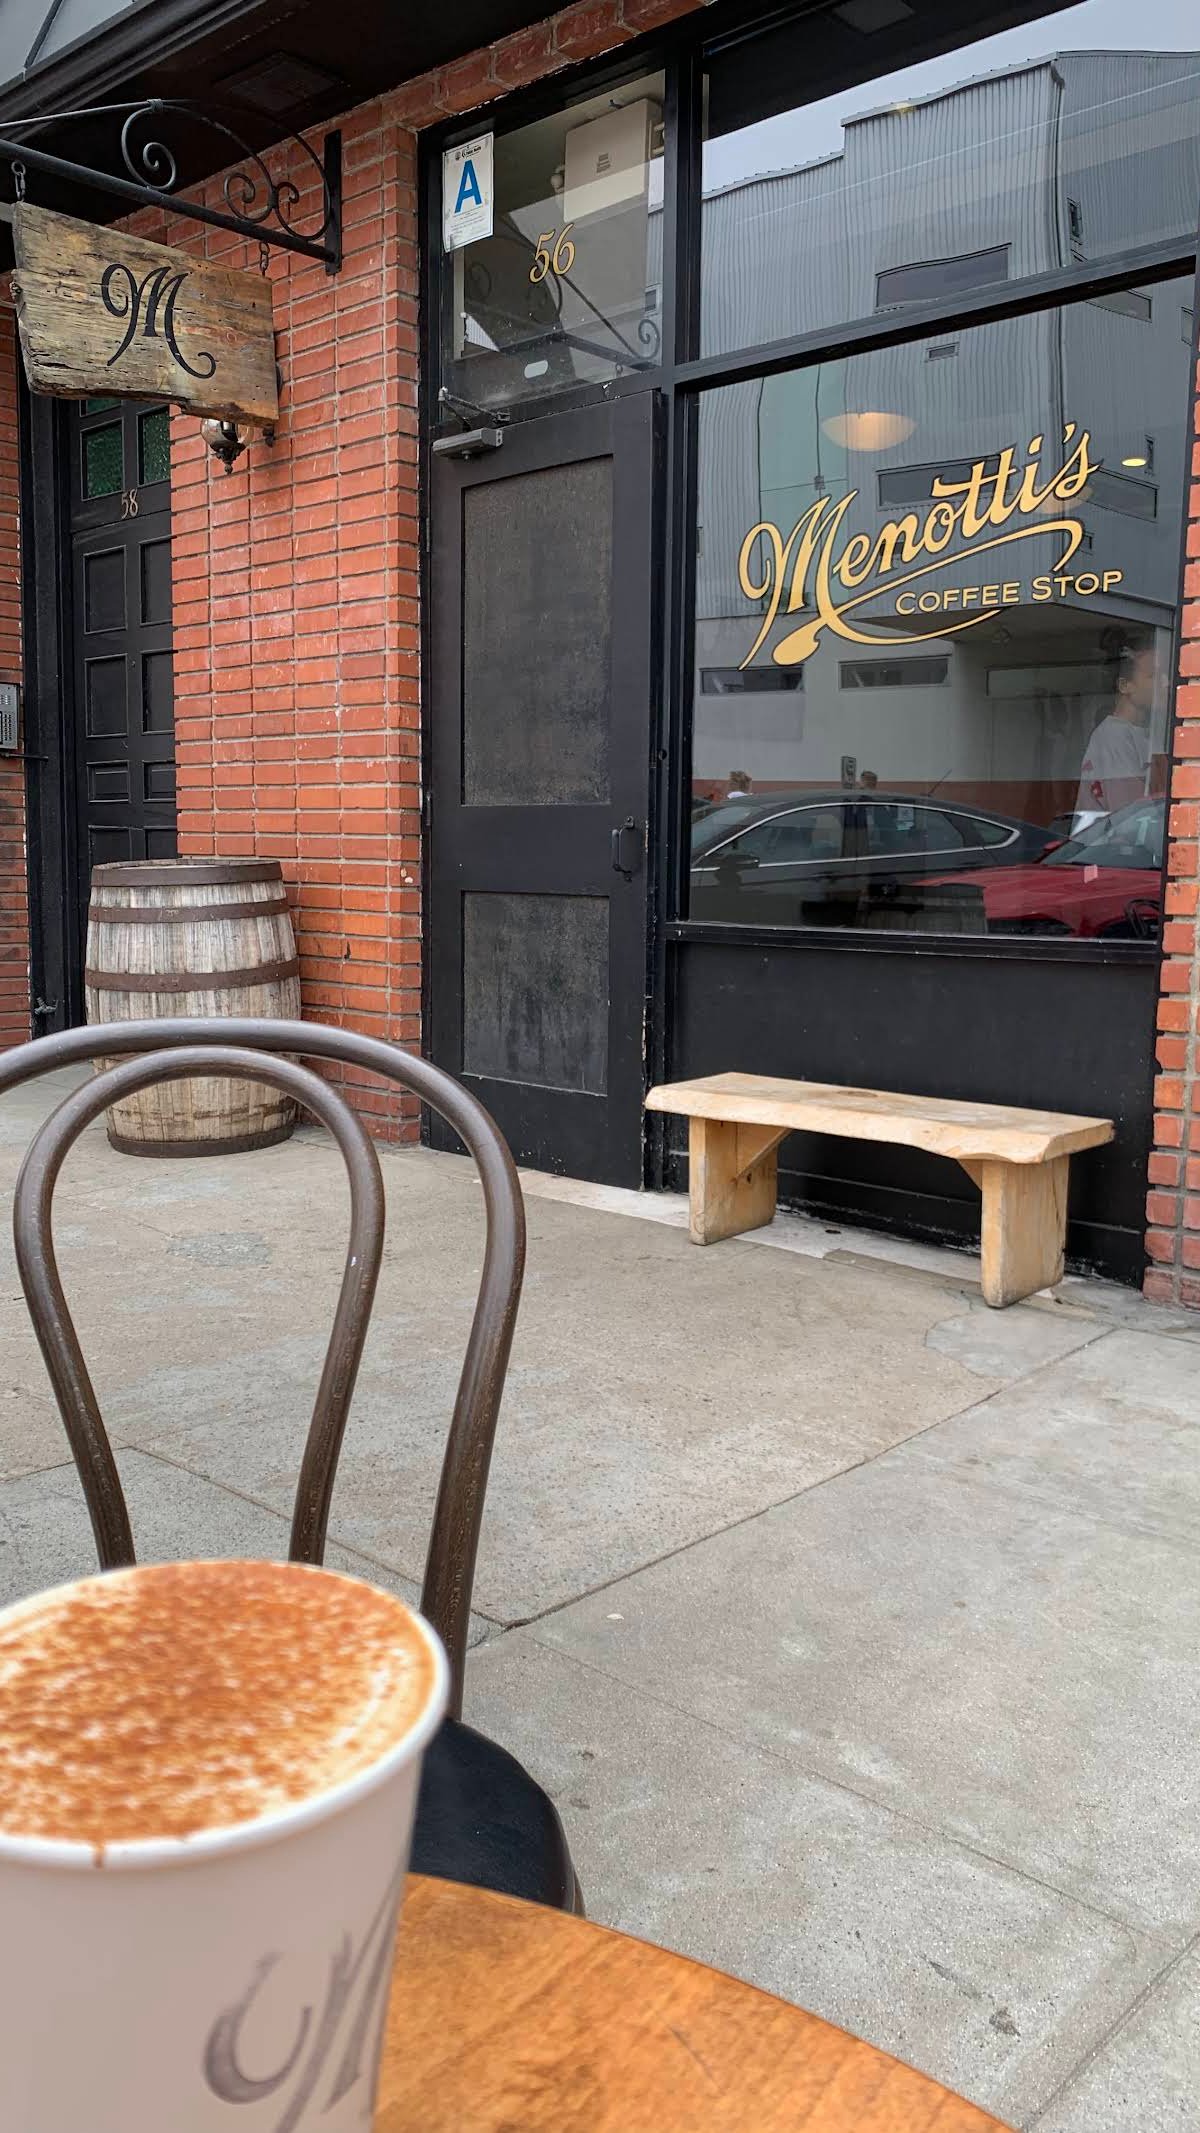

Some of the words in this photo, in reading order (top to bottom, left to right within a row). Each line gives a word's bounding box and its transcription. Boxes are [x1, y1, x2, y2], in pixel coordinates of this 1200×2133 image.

[454, 159, 483, 214] A
[529, 222, 576, 284] 56
[101, 262, 217, 380] M
[120, 488, 139, 521] 58
[737, 420, 1101, 671] Menotti's
[894, 580, 1021, 616] COFFEE
[1031, 568, 1125, 602] STOP
